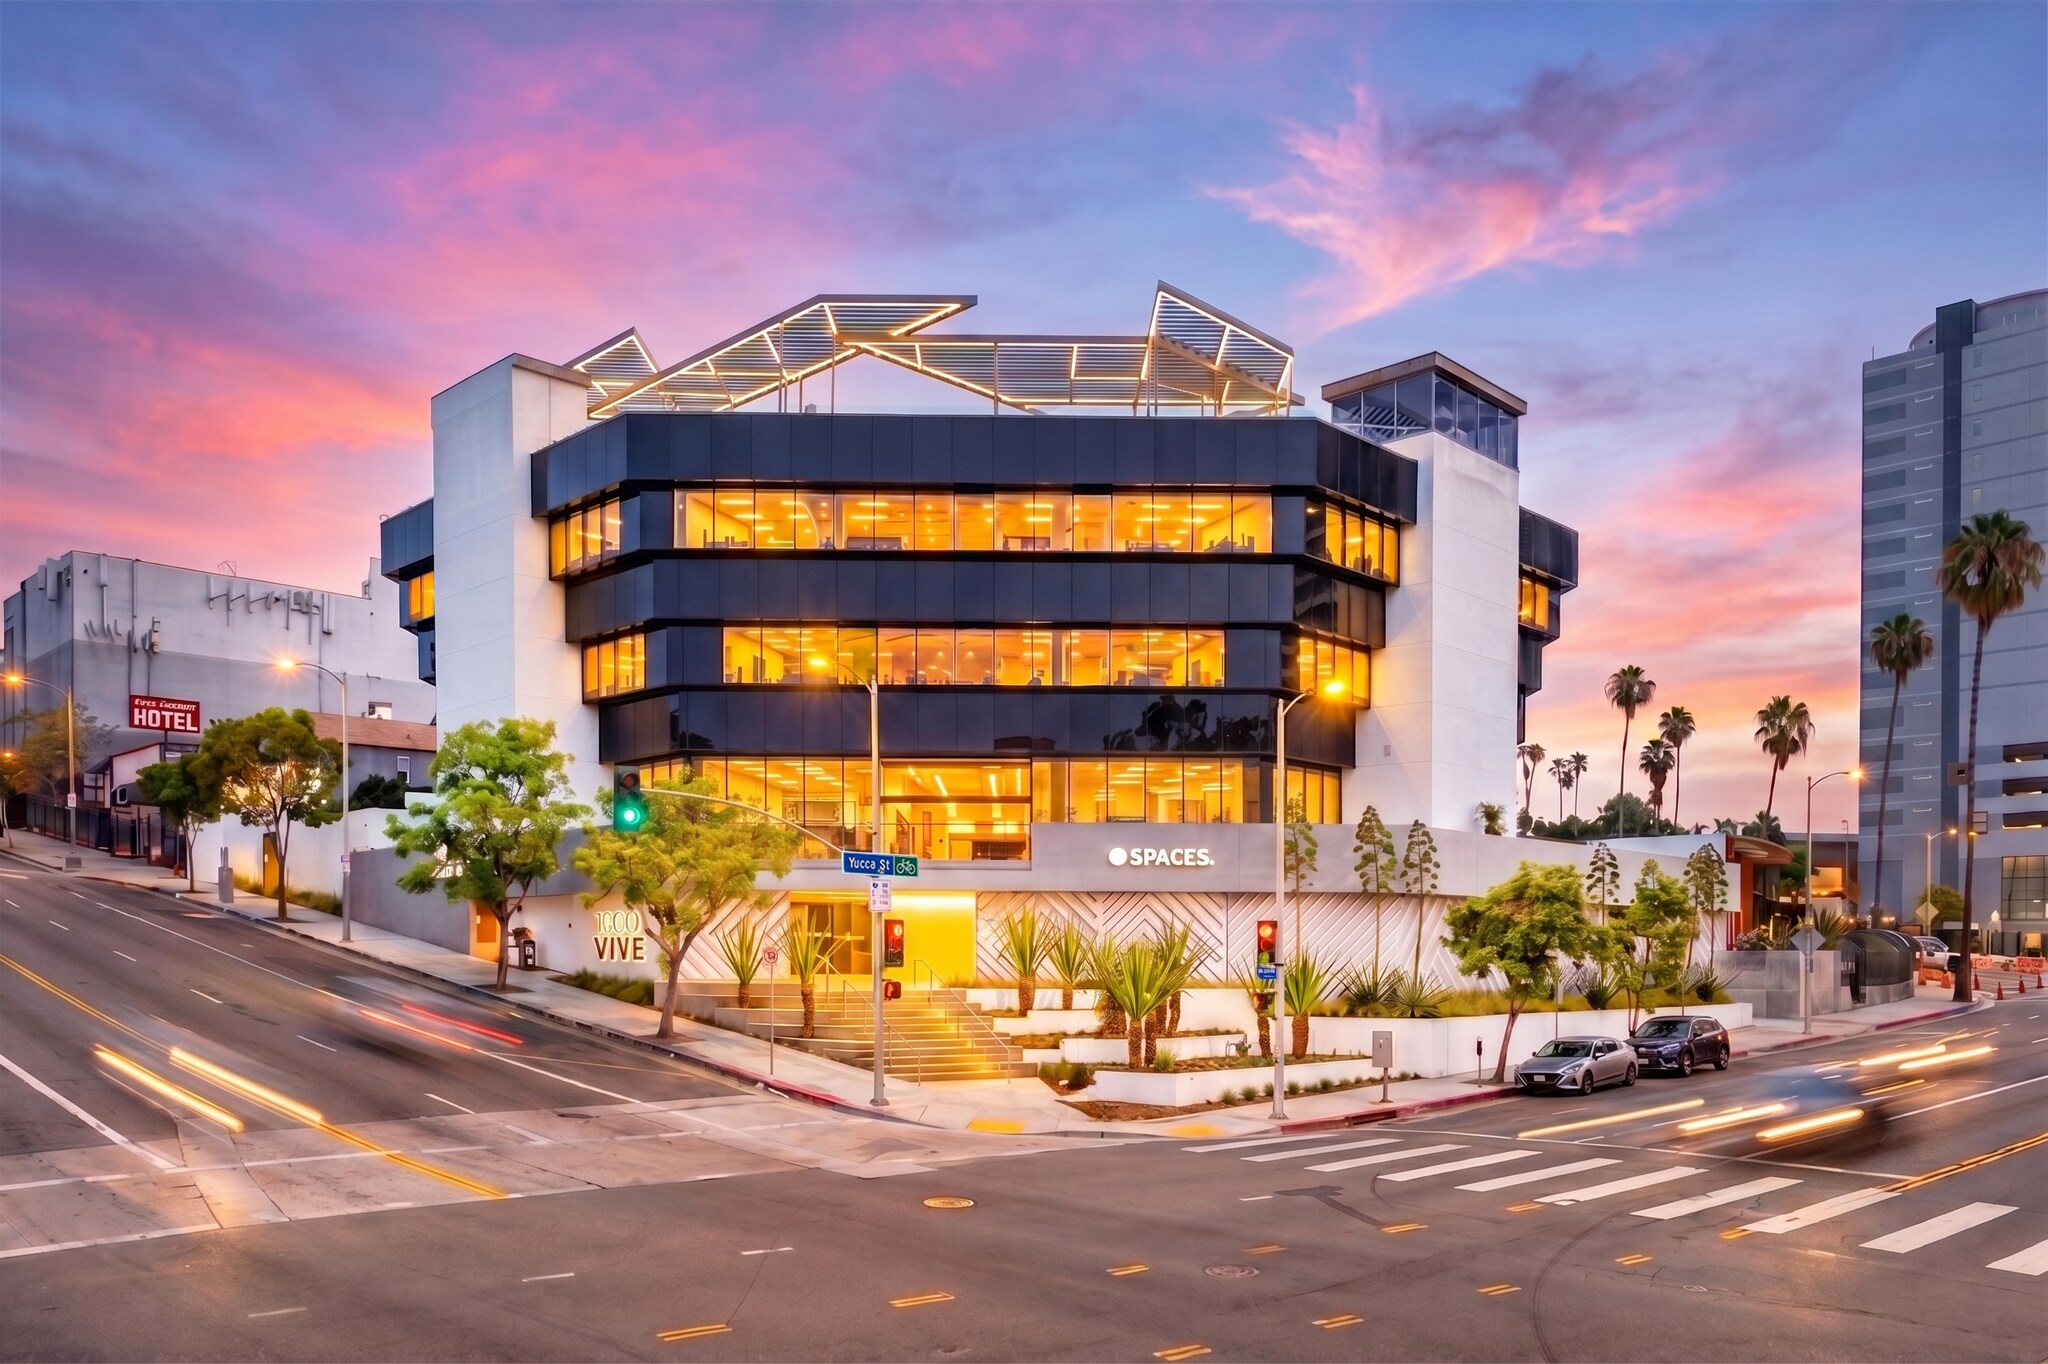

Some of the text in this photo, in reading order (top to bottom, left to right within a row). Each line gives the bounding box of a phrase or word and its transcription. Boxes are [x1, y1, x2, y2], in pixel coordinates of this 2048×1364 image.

[133, 708, 198, 731] HOTEL
[848, 857, 890, 871] Yucca St
[1130, 848, 1215, 866] SPACES.
[593, 937, 644, 960] VIVE
